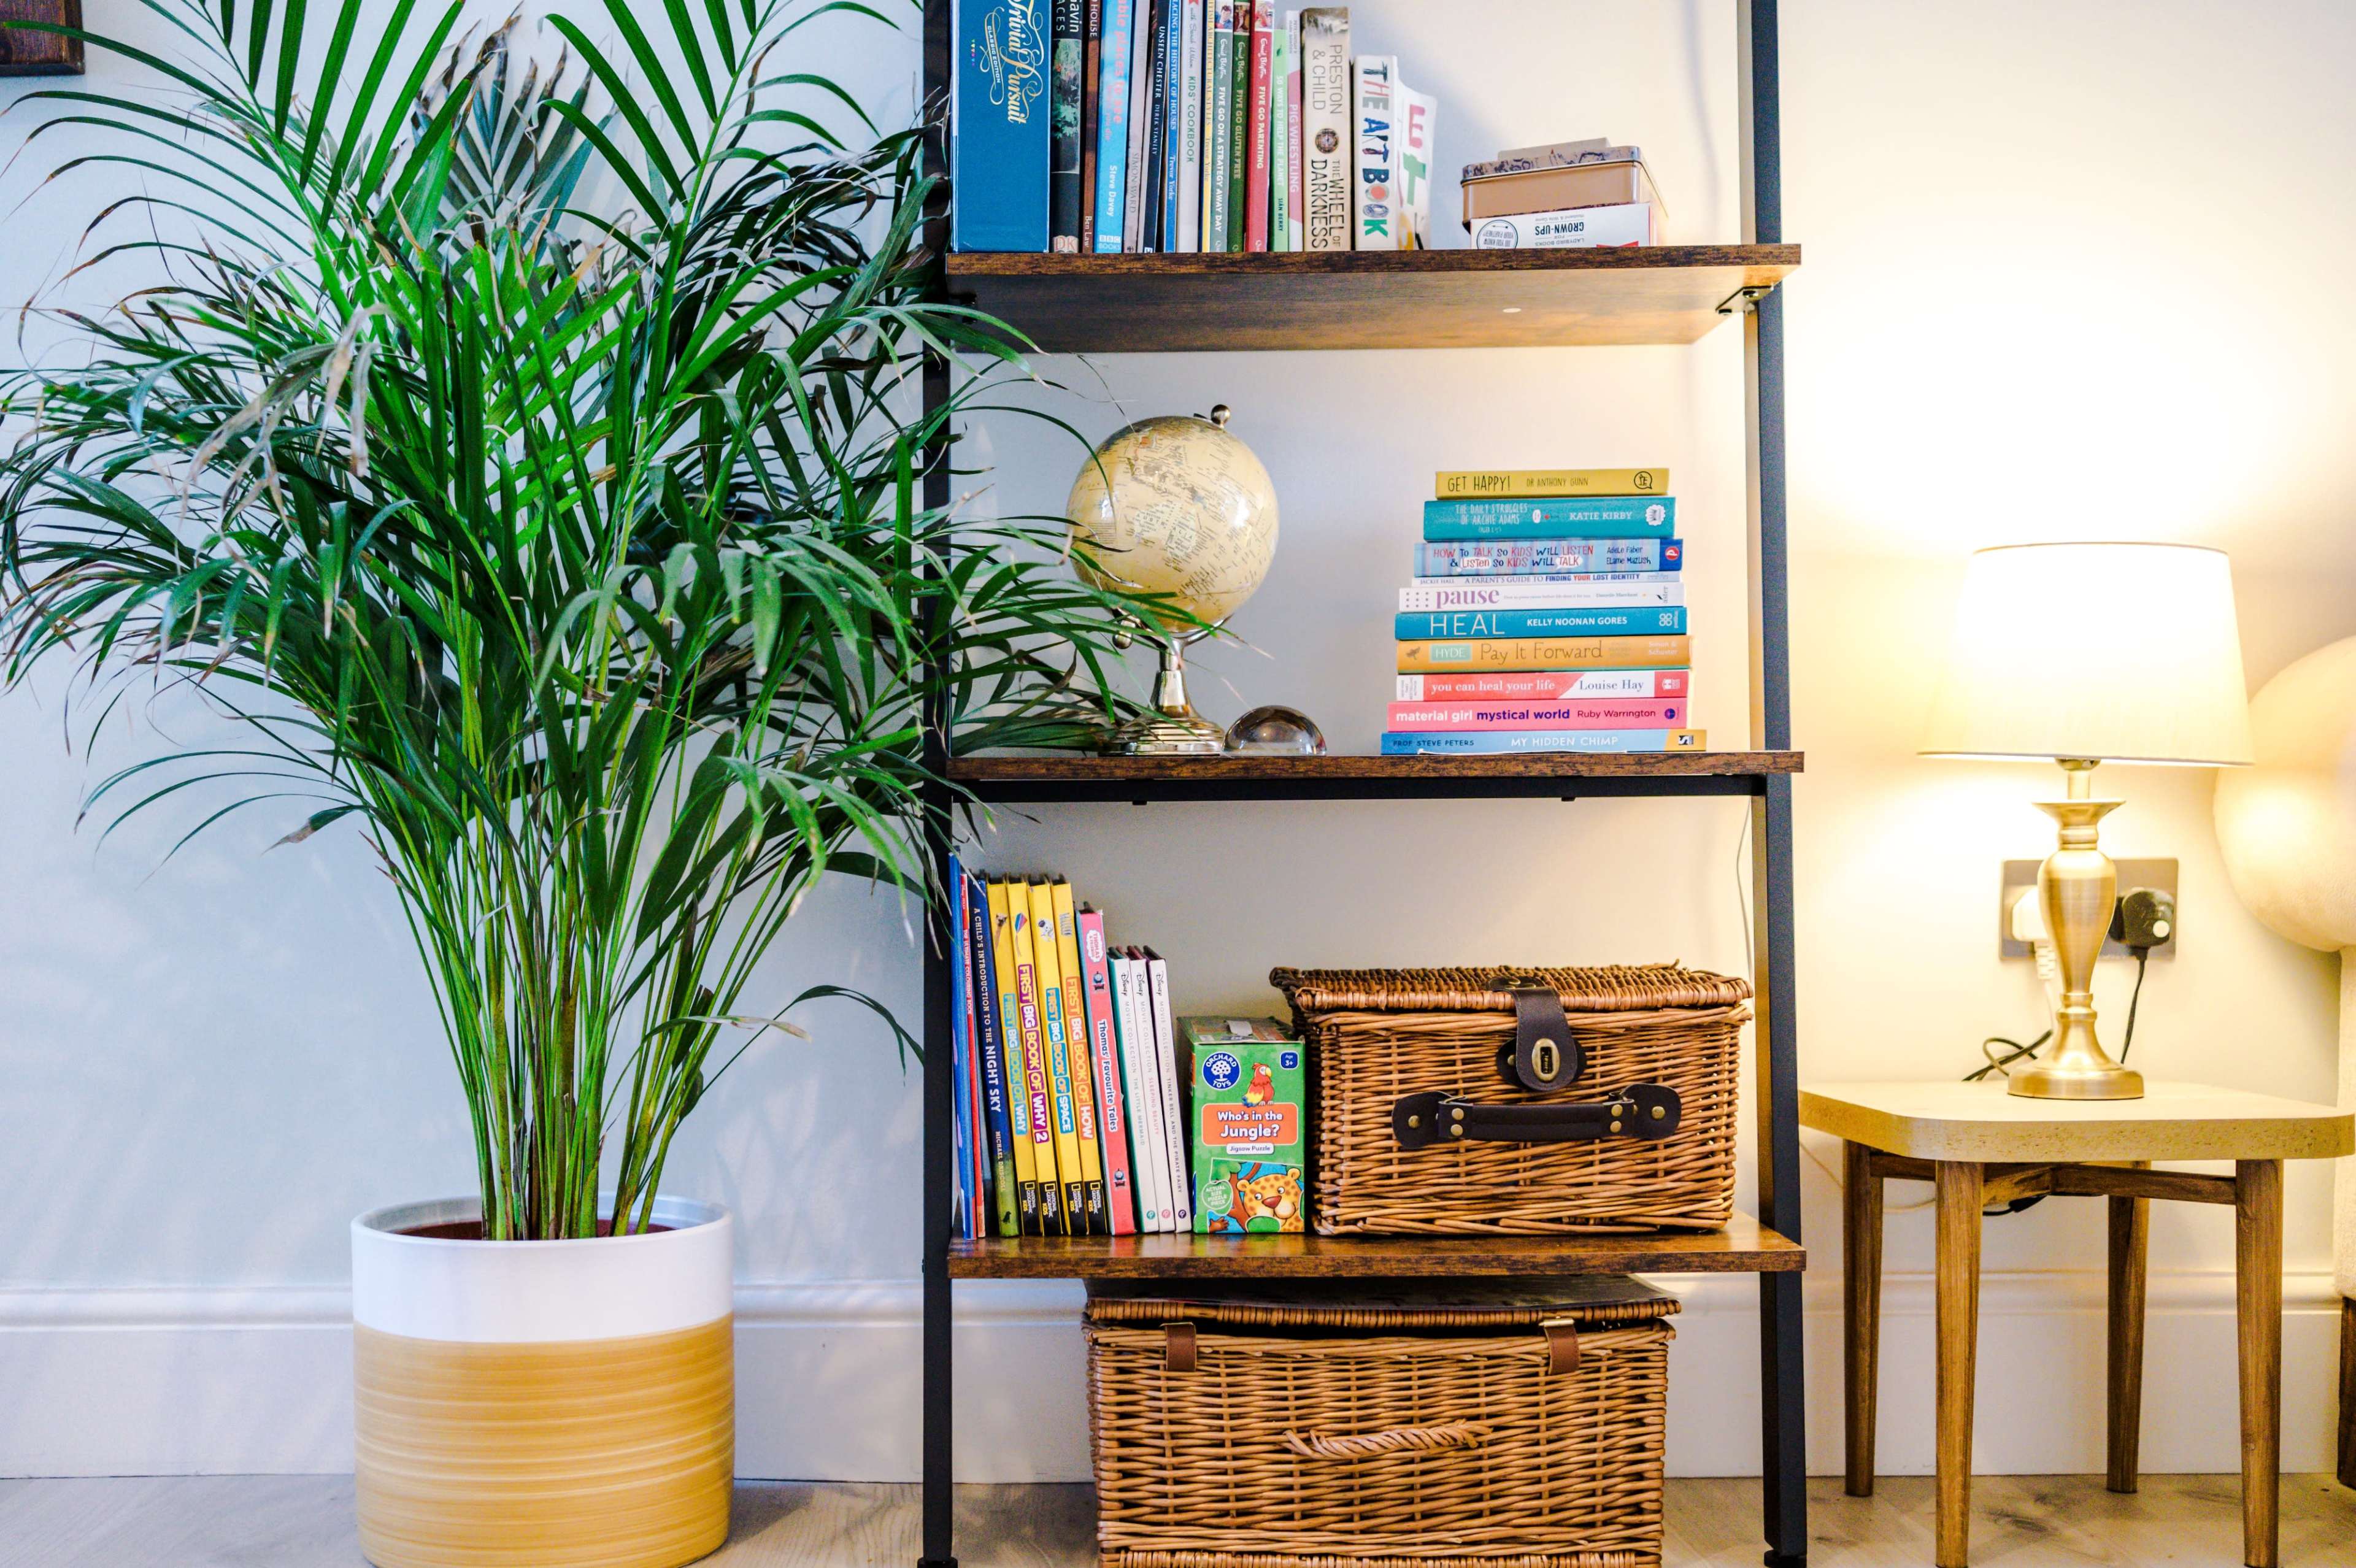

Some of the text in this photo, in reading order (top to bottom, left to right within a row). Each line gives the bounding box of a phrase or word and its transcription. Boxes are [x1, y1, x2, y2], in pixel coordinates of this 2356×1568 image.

[1157, 26, 1166, 59] UNSEEN
[987, 25, 1001, 83] CLASSIC EDITION
[999, 46, 1043, 124] Pursuit
[1155, 61, 1163, 98] CHESTER
[1312, 50, 1326, 110] & CHILD
[1329, 45, 1342, 114] PRESTON
[1171, 86, 1177, 97] OF
[1218, 107, 1225, 121] GO
[1258, 107, 1265, 120] GO
[1187, 104, 1196, 163] COOKBOOK
[1217, 123, 1225, 135] ON
[1257, 123, 1265, 169] PARENTING
[1289, 104, 1299, 193] PIG WRESTLING
[1361, 61, 1390, 237] THE ART BOOK
[1107, 191, 1117, 217] Davey
[1311, 159, 1328, 249] DARKNESS
[1329, 159, 1344, 246] THE WHEEL OF
[1534, 221, 1584, 236] GROWN-UPS
[1055, 236, 1078, 250] DK
[1448, 475, 1511, 492] GET HAPPY!
[1526, 477, 1588, 487] DR ANTHONY GUNN
[1569, 511, 1632, 521] KATIE KIRBY
[1433, 548, 1455, 558] HOW
[1472, 547, 1492, 557] TALK
[1511, 547, 1533, 556] KIDS
[1562, 545, 1593, 555] LISTEN
[1450, 558, 1458, 567] &
[1507, 558, 1528, 567] KIDS
[1558, 556, 1580, 566] TALK
[1436, 589, 1499, 609] pause
[1430, 613, 1505, 636] HEAL
[1527, 618, 1552, 627] KELLY
[1598, 617, 1628, 625] GORES
[1435, 647, 1466, 658] HYDE
[1480, 643, 1509, 665] Pay
[1515, 643, 1526, 659] It
[1534, 640, 1603, 659] Forward
[1431, 682, 1452, 694] you
[1455, 682, 1475, 691] can
[1479, 680, 1503, 691] heal
[1506, 682, 1533, 694] your
[1536, 679, 1555, 690] life
[1579, 679, 1644, 692] Louise Hay
[1396, 709, 1571, 723] material girl mystical world
[1577, 709, 1657, 719] Ruby Warrington
[1511, 736, 1619, 747] MY HIDDEN CHIMP
[974, 916, 984, 948] CHILD'S
[978, 950, 989, 1012] INTRODUCTION
[1136, 970, 1145, 996] Disney
[984, 1013, 991, 1025] TO
[1020, 966, 1048, 1142] FIRST BIG BOOK OF WHY 2
[1047, 989, 1071, 1132] FIRST BIG BOOK OF SPACE
[1067, 978, 1093, 1139] FIRST BIG BOOK OF HOW
[1206, 1054, 1237, 1067] ORCHARD
[985, 1045, 999, 1085] NIGHT
[1099, 1020, 1117, 1131] Thomas' Favourite Tales
[1213, 1080, 1231, 1088] TOYS
[989, 1089, 1001, 1112] SKY
[1217, 1110, 1284, 1121] Who's in the
[1220, 1123, 1280, 1140] Jungle?
